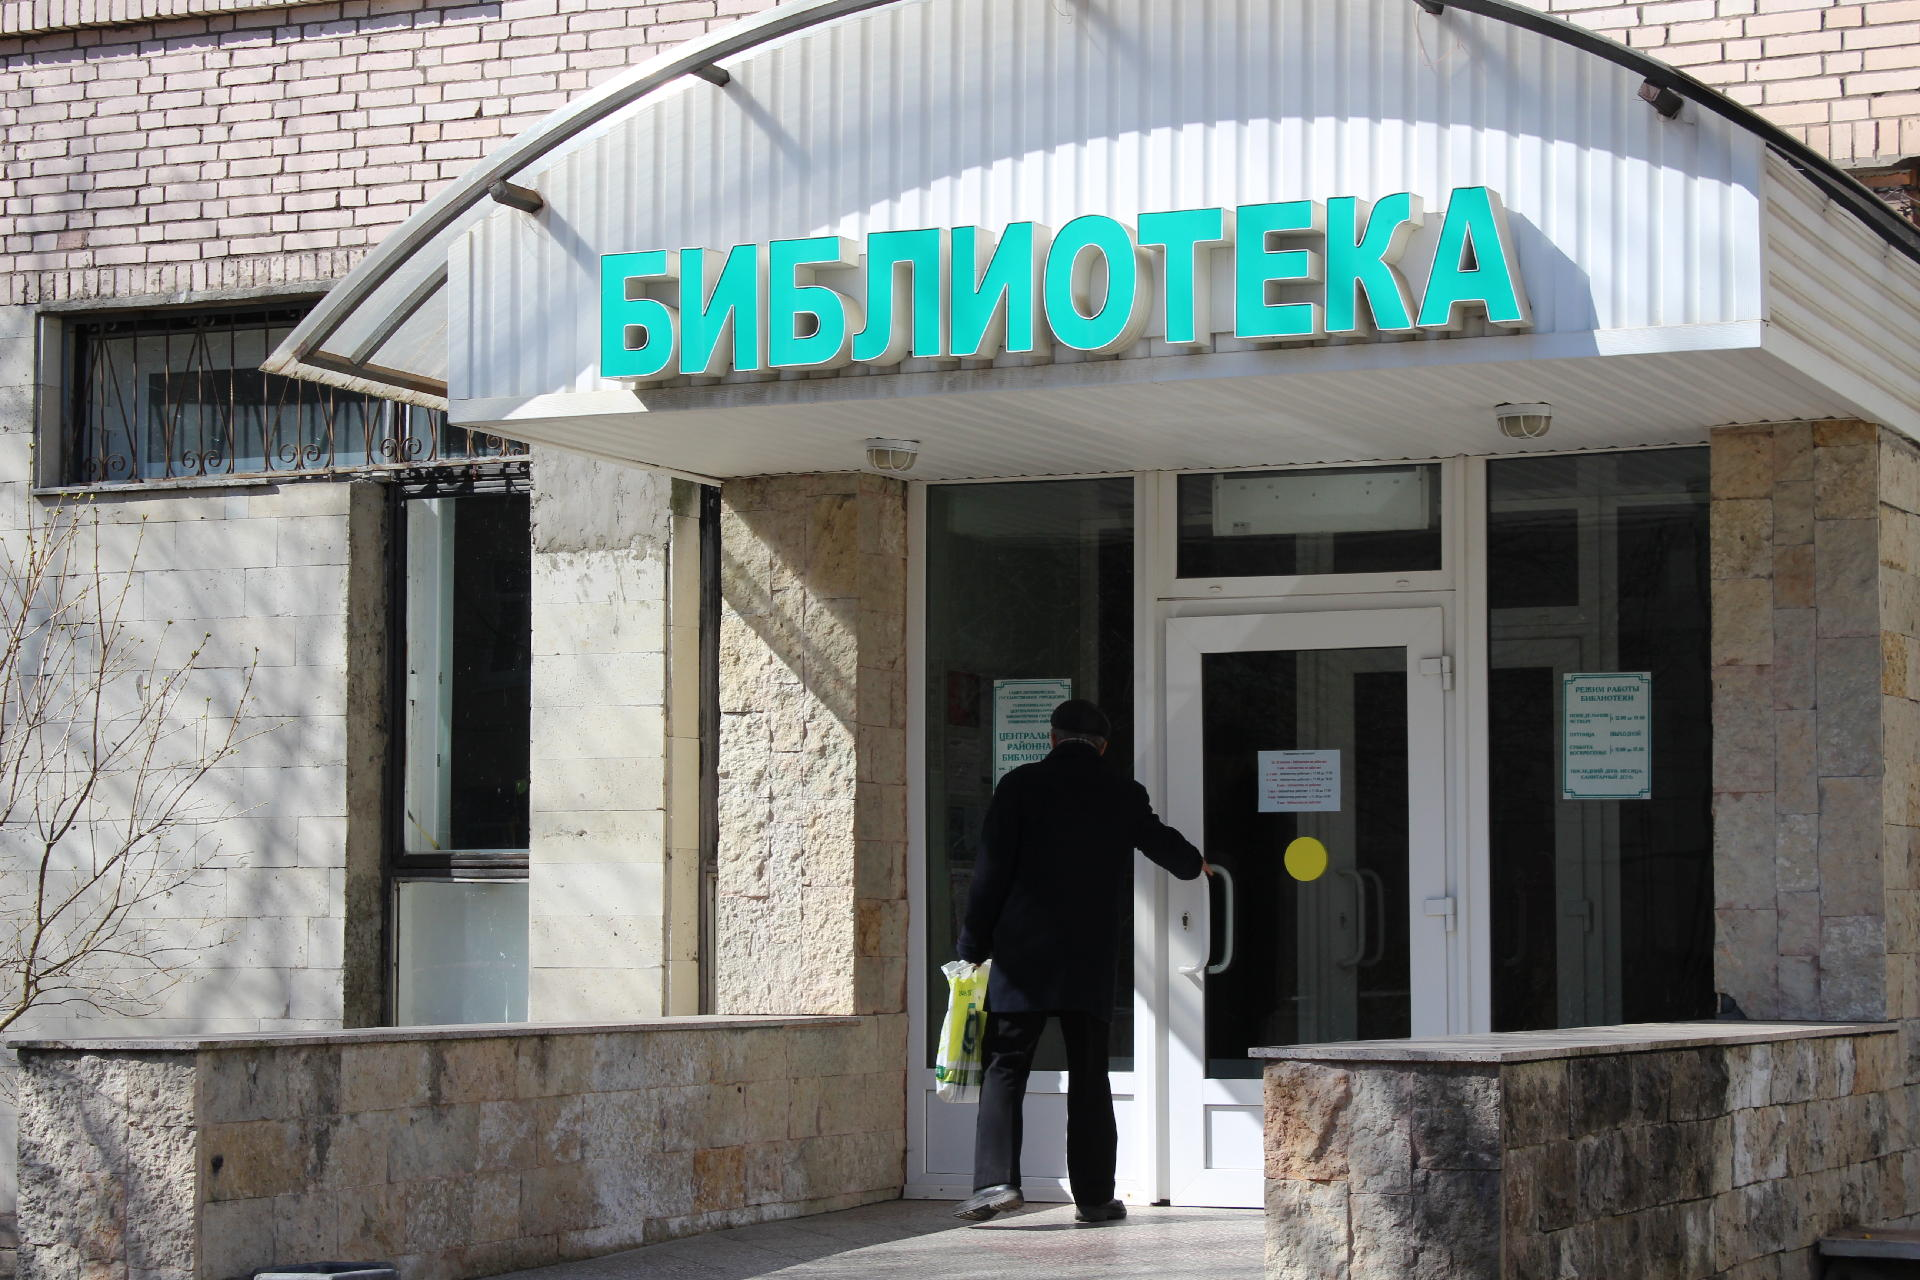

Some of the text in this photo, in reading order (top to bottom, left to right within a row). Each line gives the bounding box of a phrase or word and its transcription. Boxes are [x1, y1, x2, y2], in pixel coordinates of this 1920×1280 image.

[600, 186, 1528, 379] БИБЛИОТЕКА
[1607, 685, 1640, 693] РАБОТЫ
[1580, 694, 1634, 702] БИБЛИОТЕКИ
[1007, 741, 1051, 750] РАЙОННА
